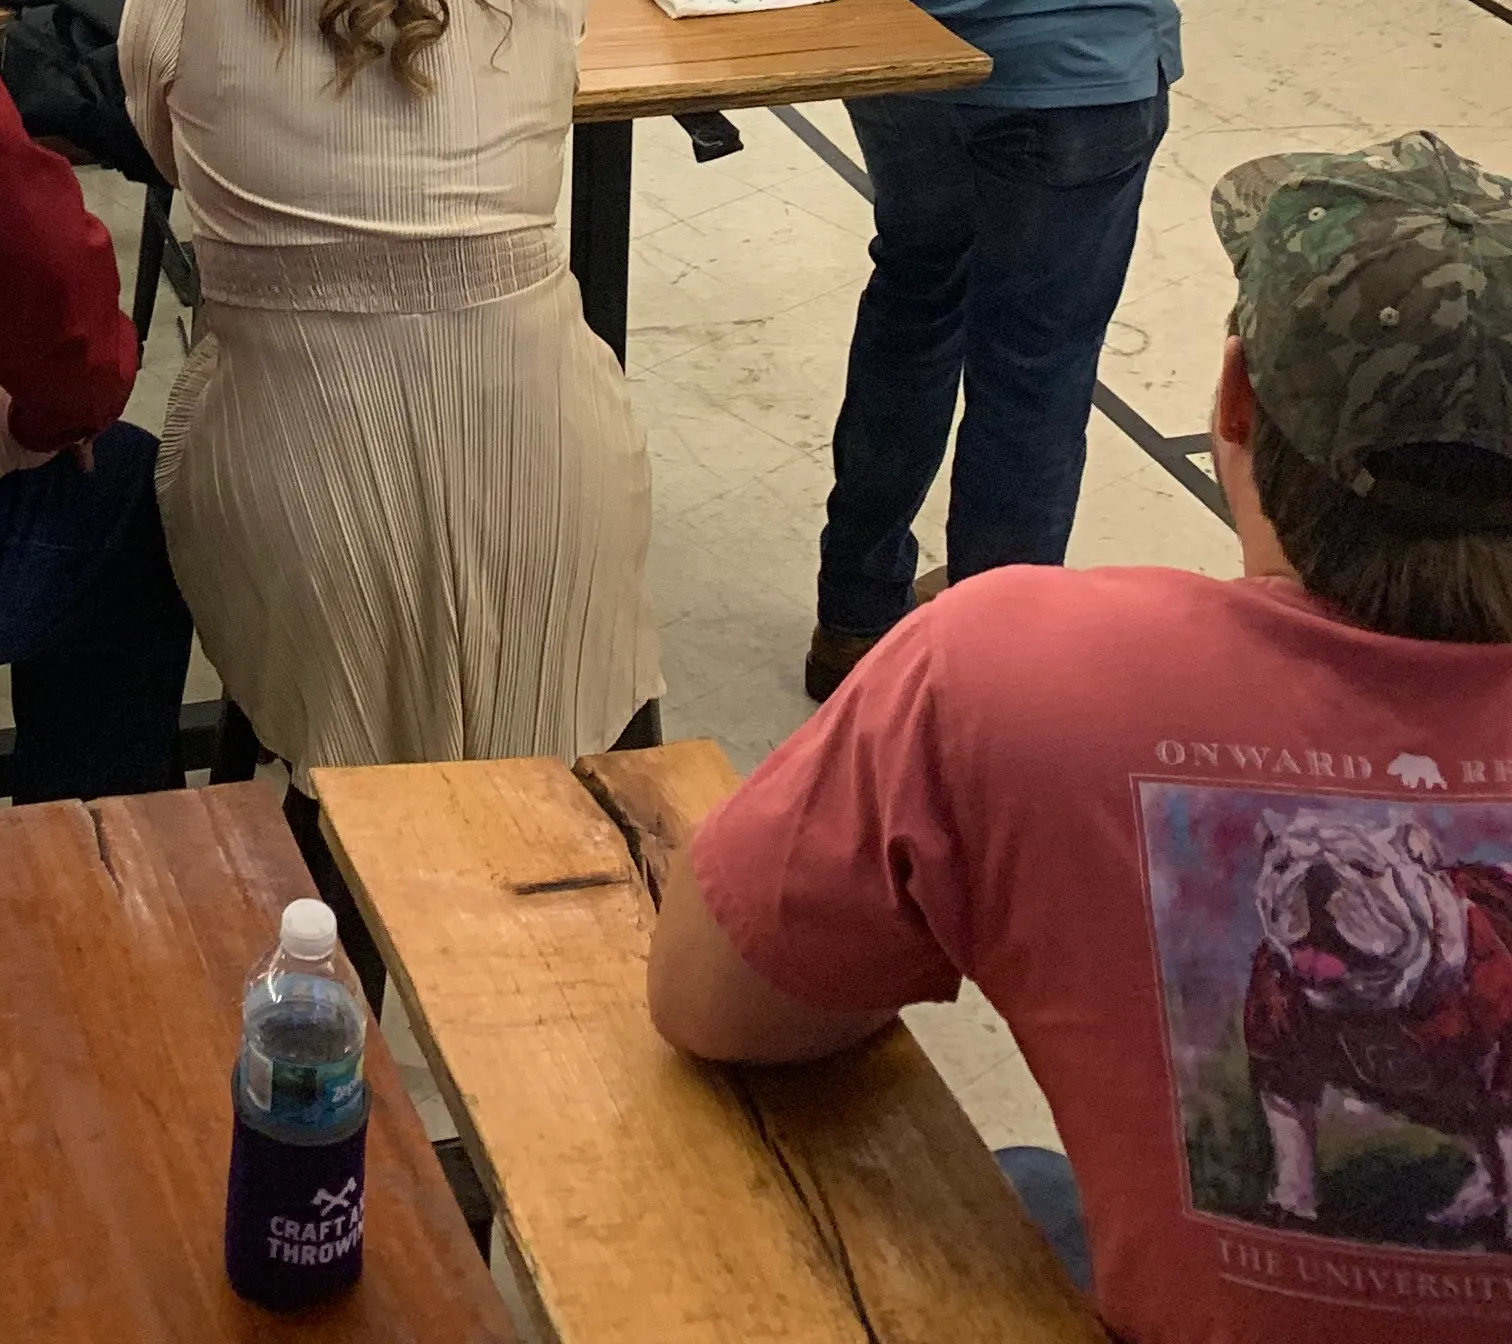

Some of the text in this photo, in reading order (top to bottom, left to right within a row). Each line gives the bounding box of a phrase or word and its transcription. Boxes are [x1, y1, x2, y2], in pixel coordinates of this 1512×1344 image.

[1154, 739, 1373, 780] ONWARD
[270, 1215, 346, 1242] CRAFT
[1218, 1237, 1281, 1275] THE
